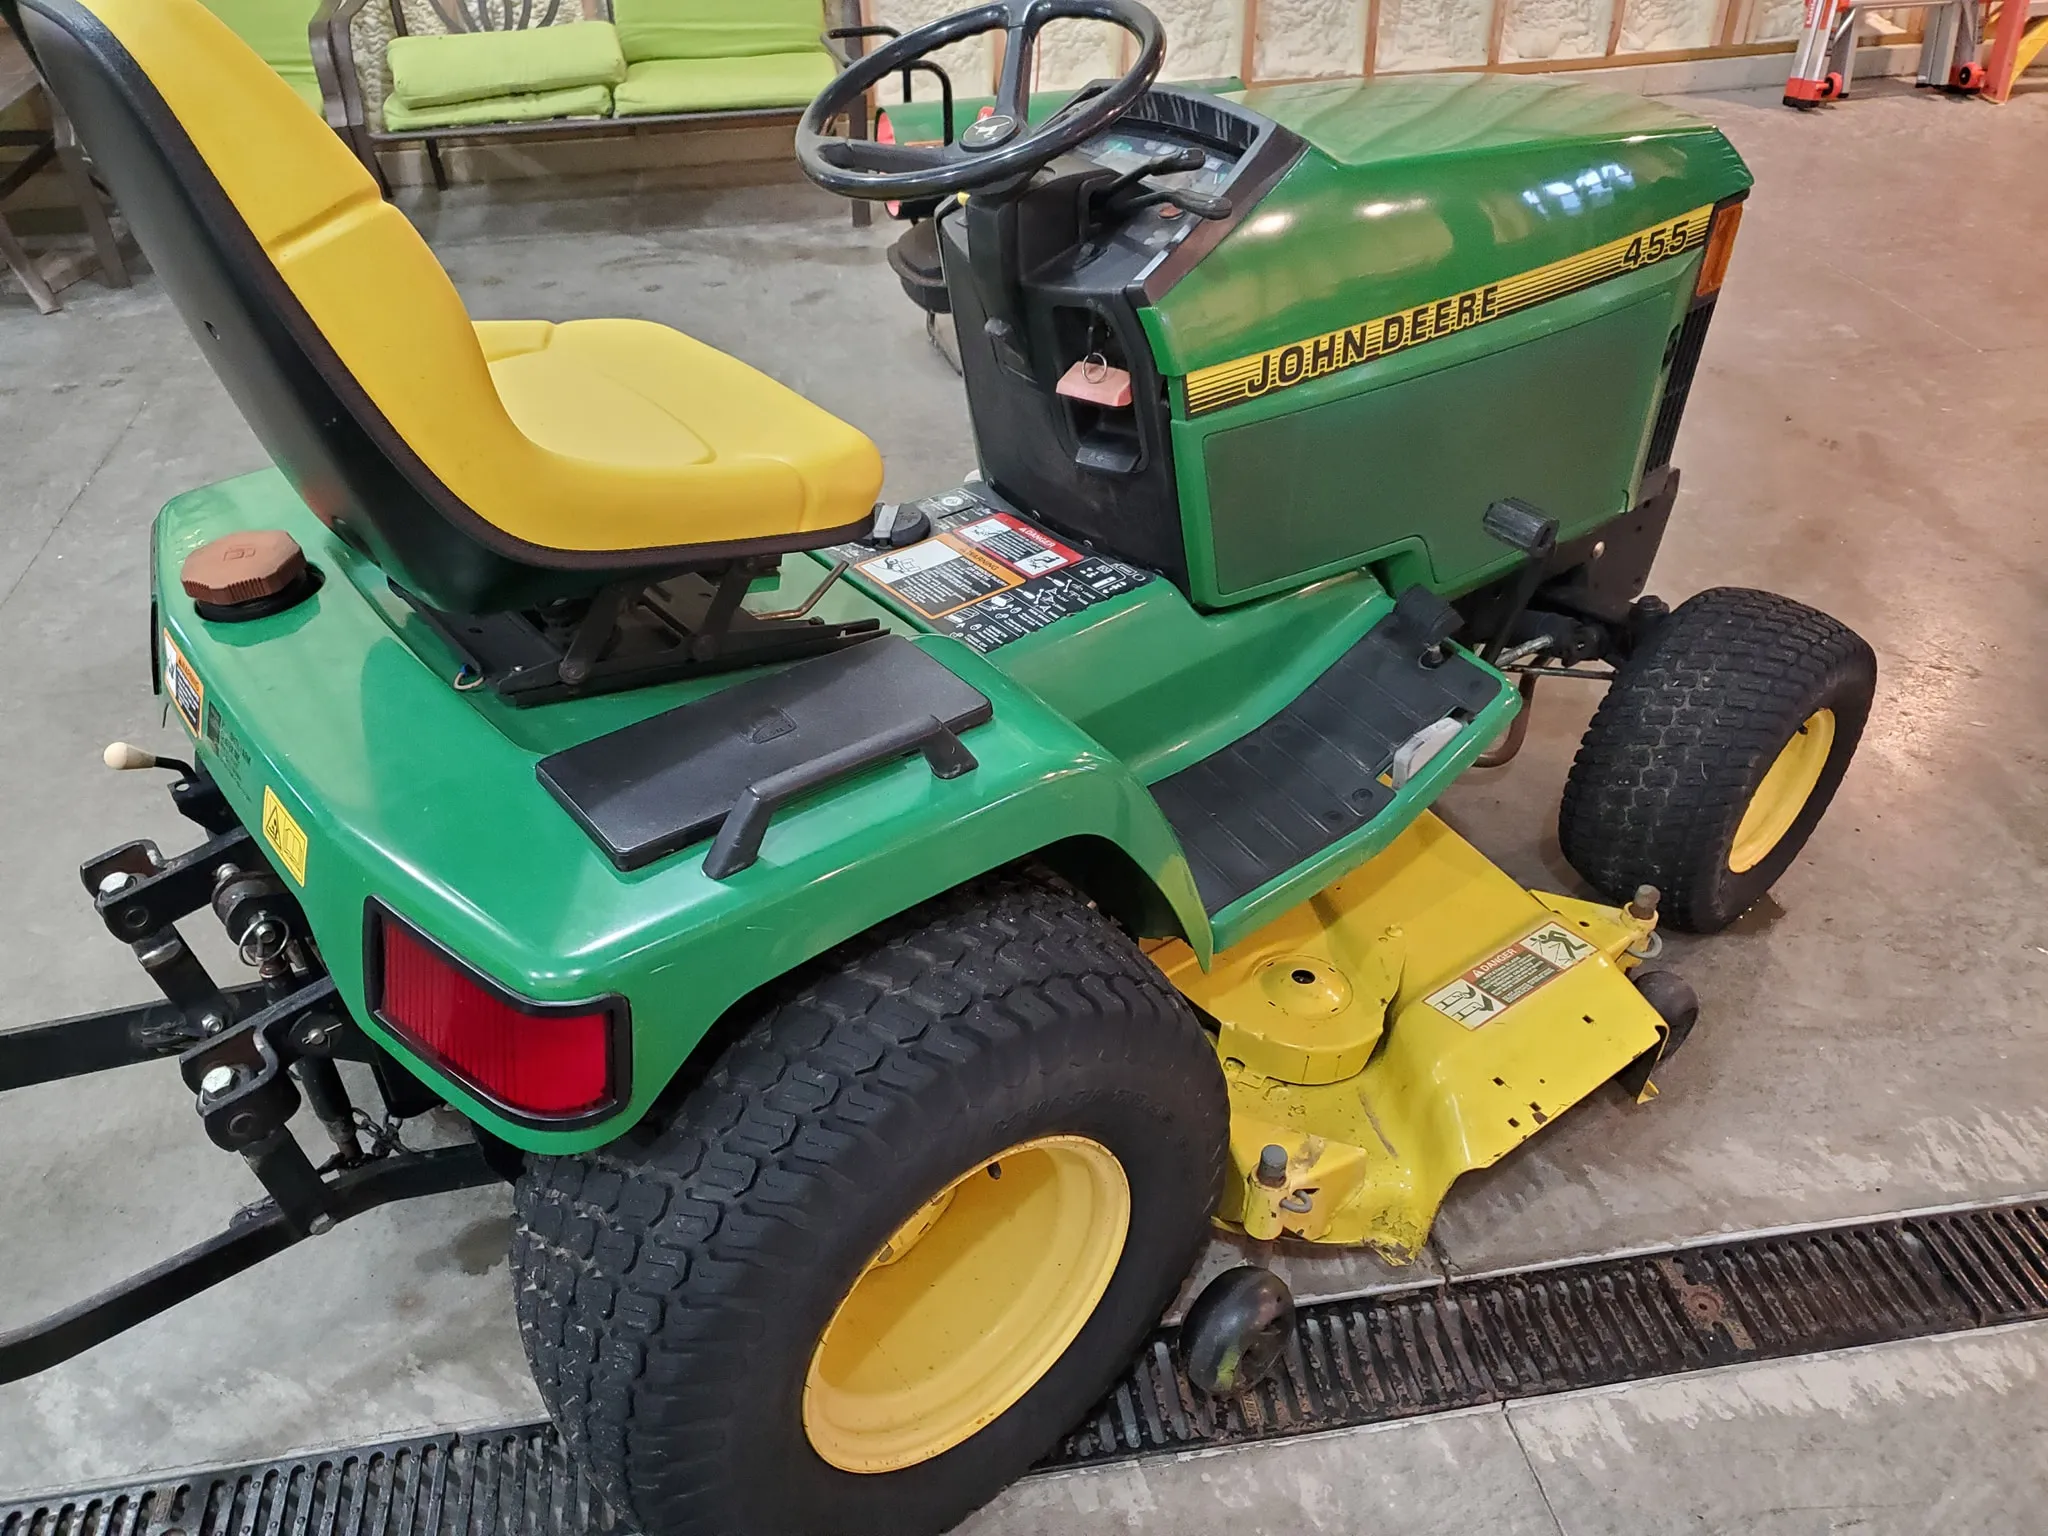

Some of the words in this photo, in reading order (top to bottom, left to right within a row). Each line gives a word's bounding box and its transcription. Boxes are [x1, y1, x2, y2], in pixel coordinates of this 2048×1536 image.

[1622, 219, 1690, 267] 455
[1247, 325, 1368, 397] JOHN
[1381, 285, 1499, 353] DEERE
[1025, 528, 1057, 548] DANGER
[966, 549, 999, 571] WARNING
[1480, 948, 1517, 972] DANGER
